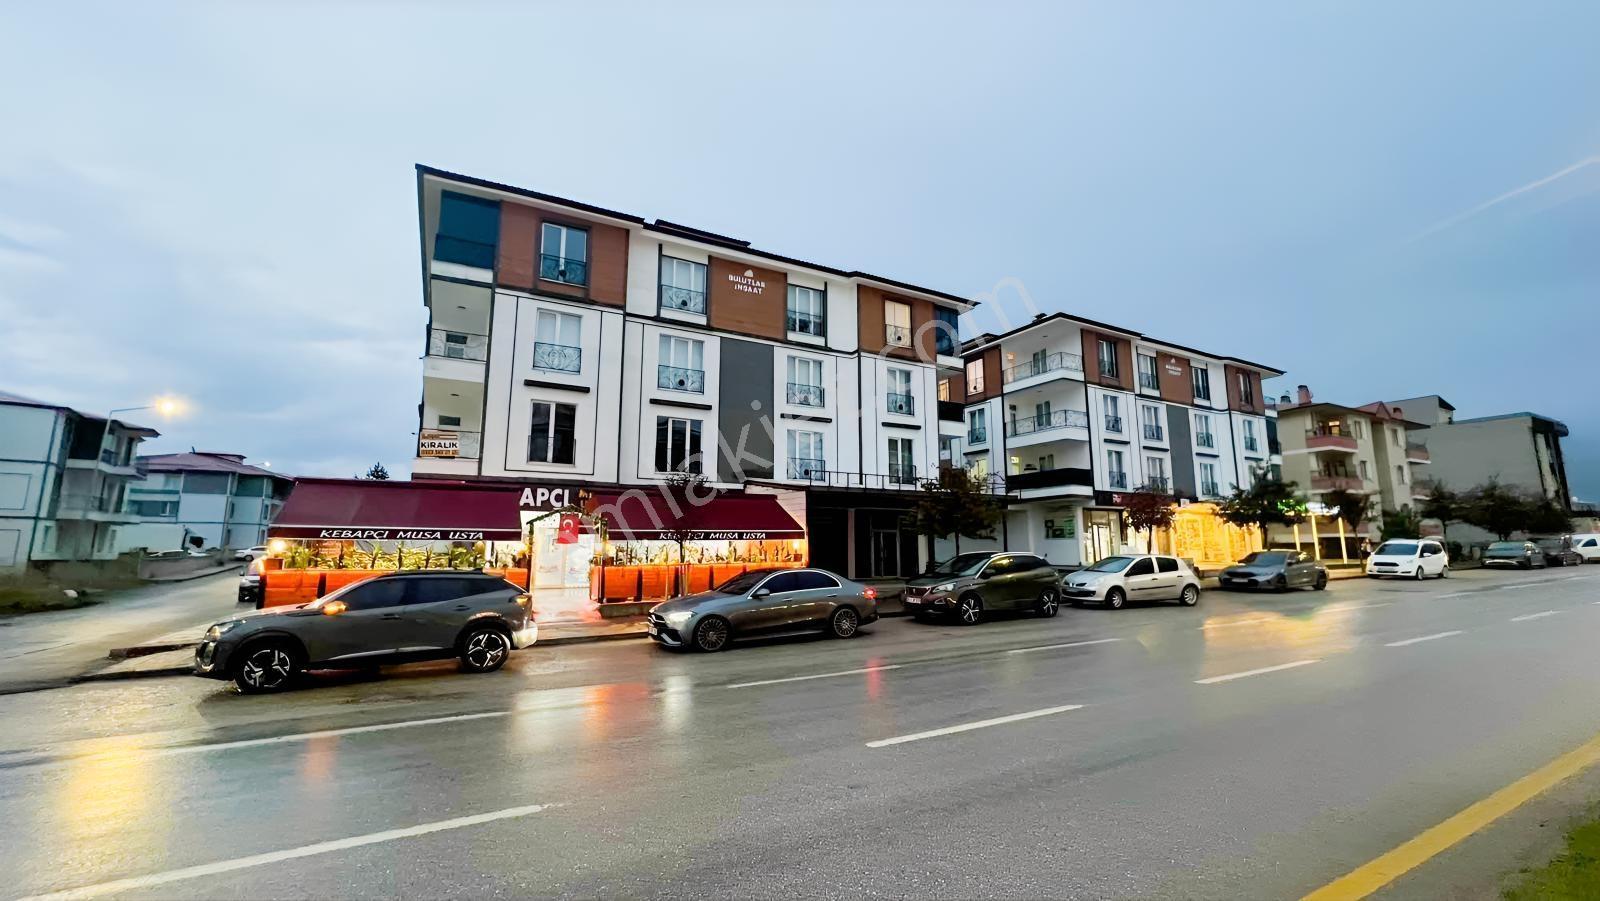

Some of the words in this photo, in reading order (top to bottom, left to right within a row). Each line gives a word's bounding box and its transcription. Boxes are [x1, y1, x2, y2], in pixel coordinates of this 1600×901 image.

[396, 530, 441, 540] MUSA
[448, 531, 484, 540] USTA
[709, 532, 739, 540] MUSA
[743, 532, 766, 540] USTA
